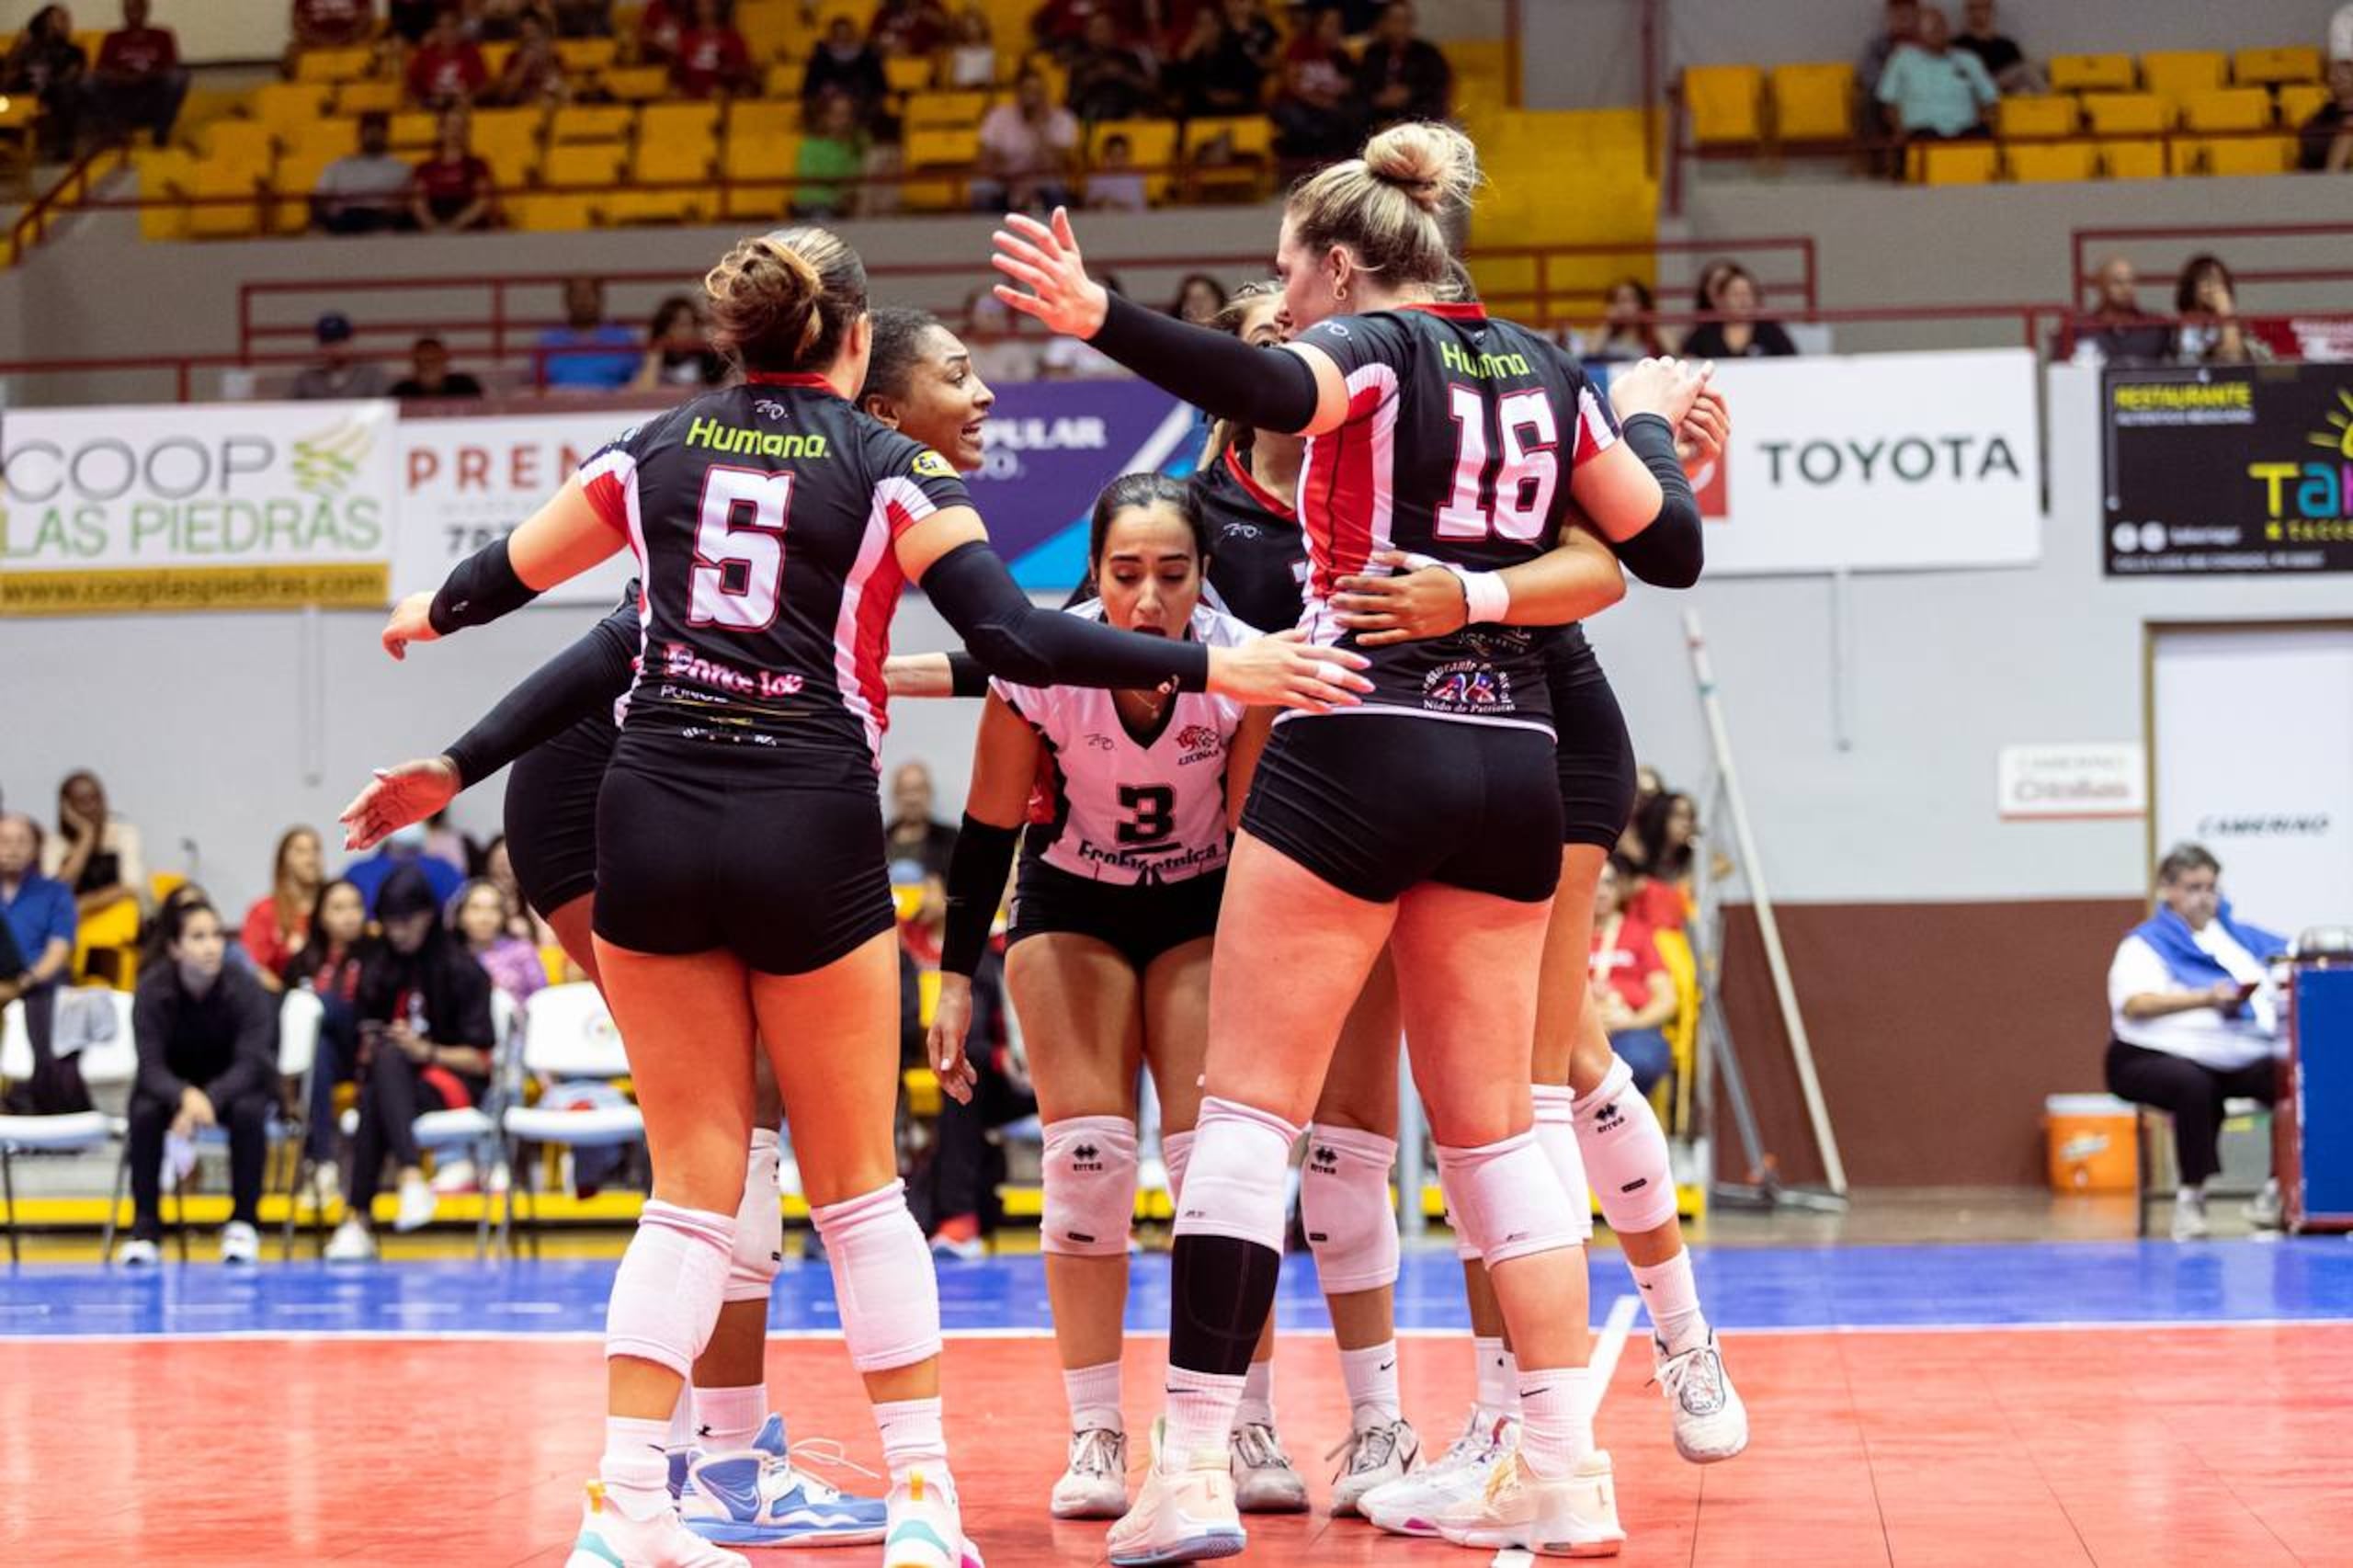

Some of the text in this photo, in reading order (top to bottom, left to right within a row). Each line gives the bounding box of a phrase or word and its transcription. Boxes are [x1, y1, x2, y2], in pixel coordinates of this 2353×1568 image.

[3, 436, 276, 504] COOP
[1433, 382, 1559, 544] 16
[1758, 435, 2021, 485] TOYOTA
[0, 494, 382, 557] LAS PIEDRAS
[686, 463, 795, 632] 5
[1116, 782, 1176, 846] 3
